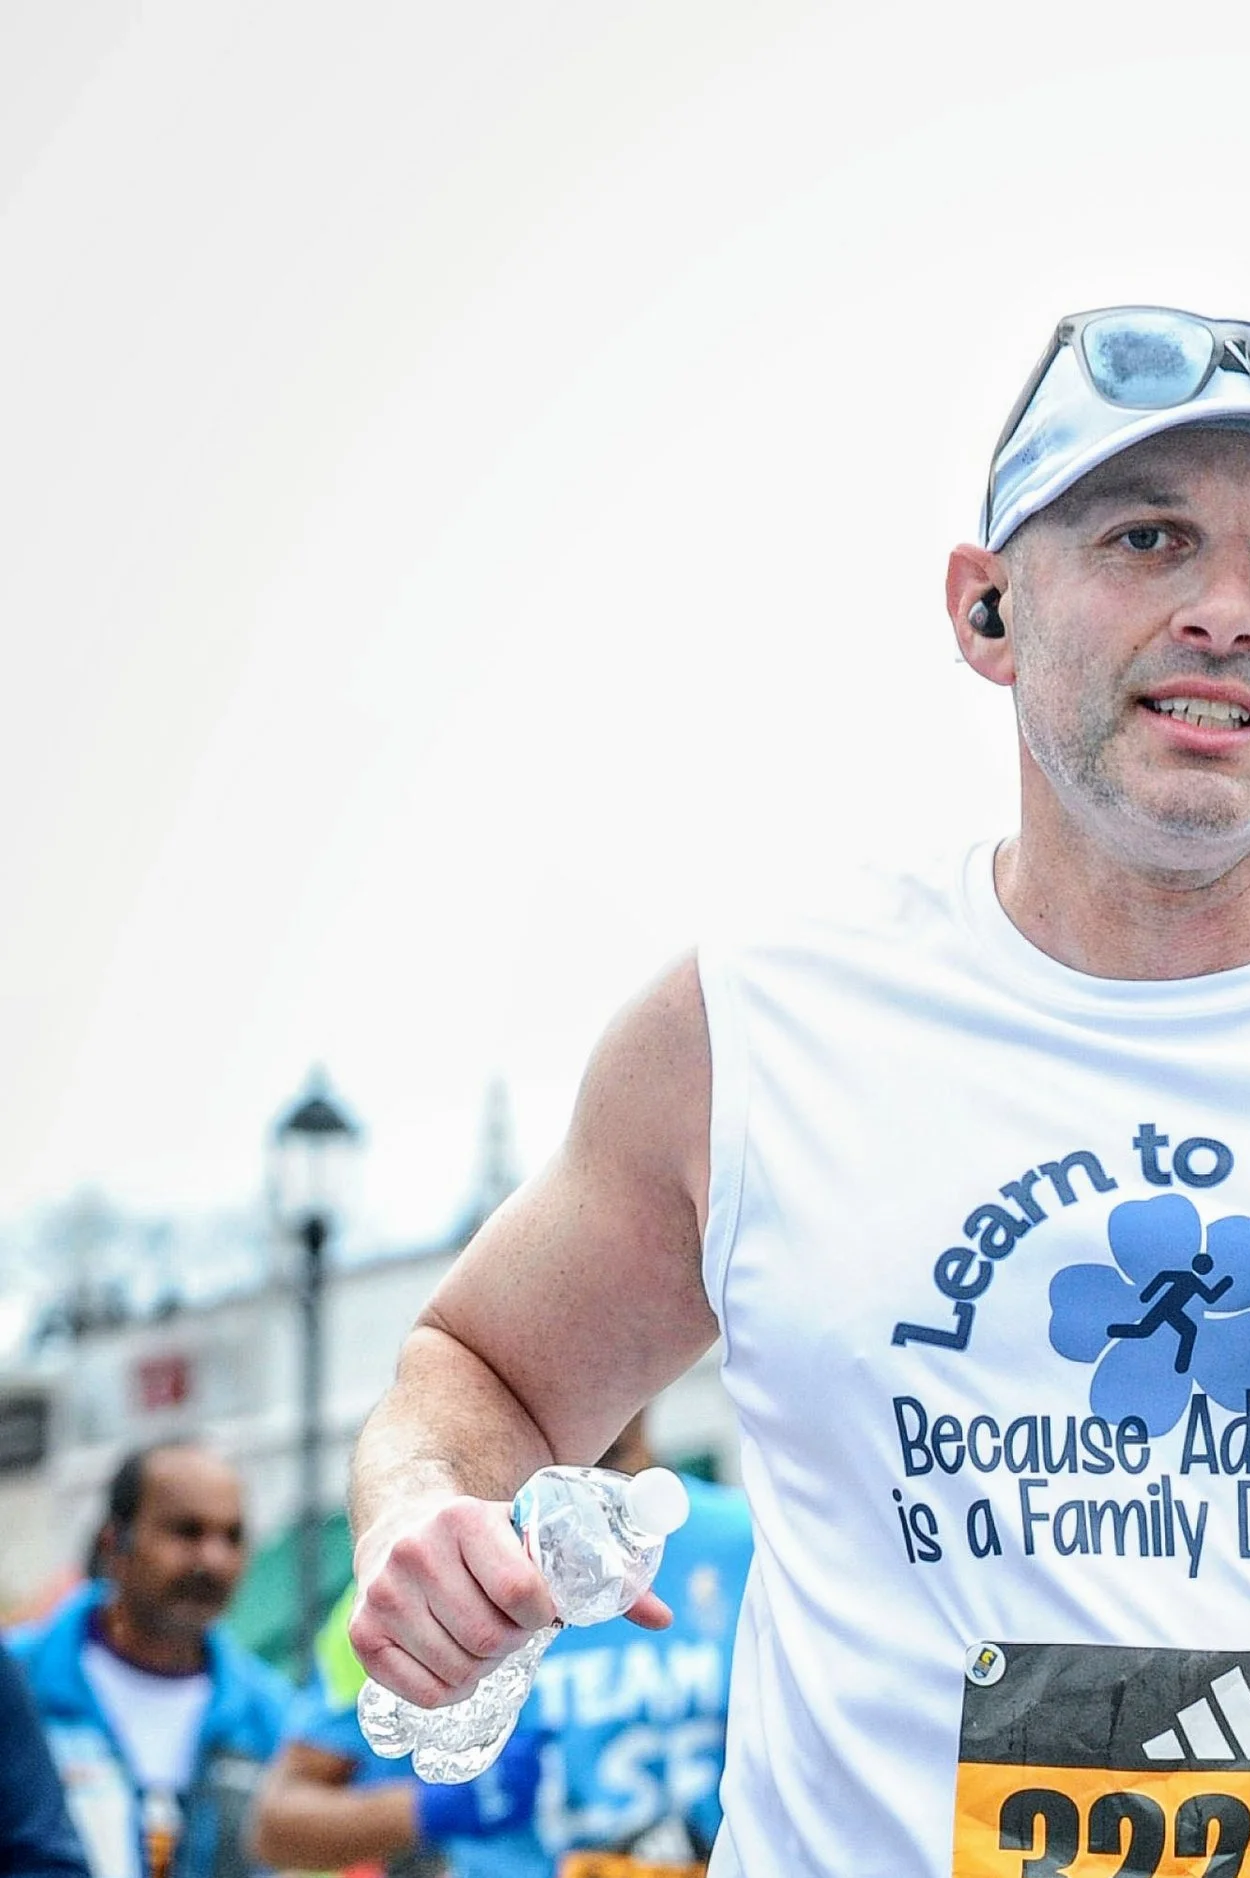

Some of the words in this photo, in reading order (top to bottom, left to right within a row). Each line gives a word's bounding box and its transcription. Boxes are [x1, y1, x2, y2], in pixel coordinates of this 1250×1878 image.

[891, 1150, 1118, 1352] Learn
[1132, 1123, 1234, 1188] to
[893, 1395, 1150, 1478] Because
[892, 1488, 943, 1563] is
[967, 1498, 1002, 1558] a
[1018, 1474, 1208, 1578] Family
[536, 1642, 722, 1724] TEAM
